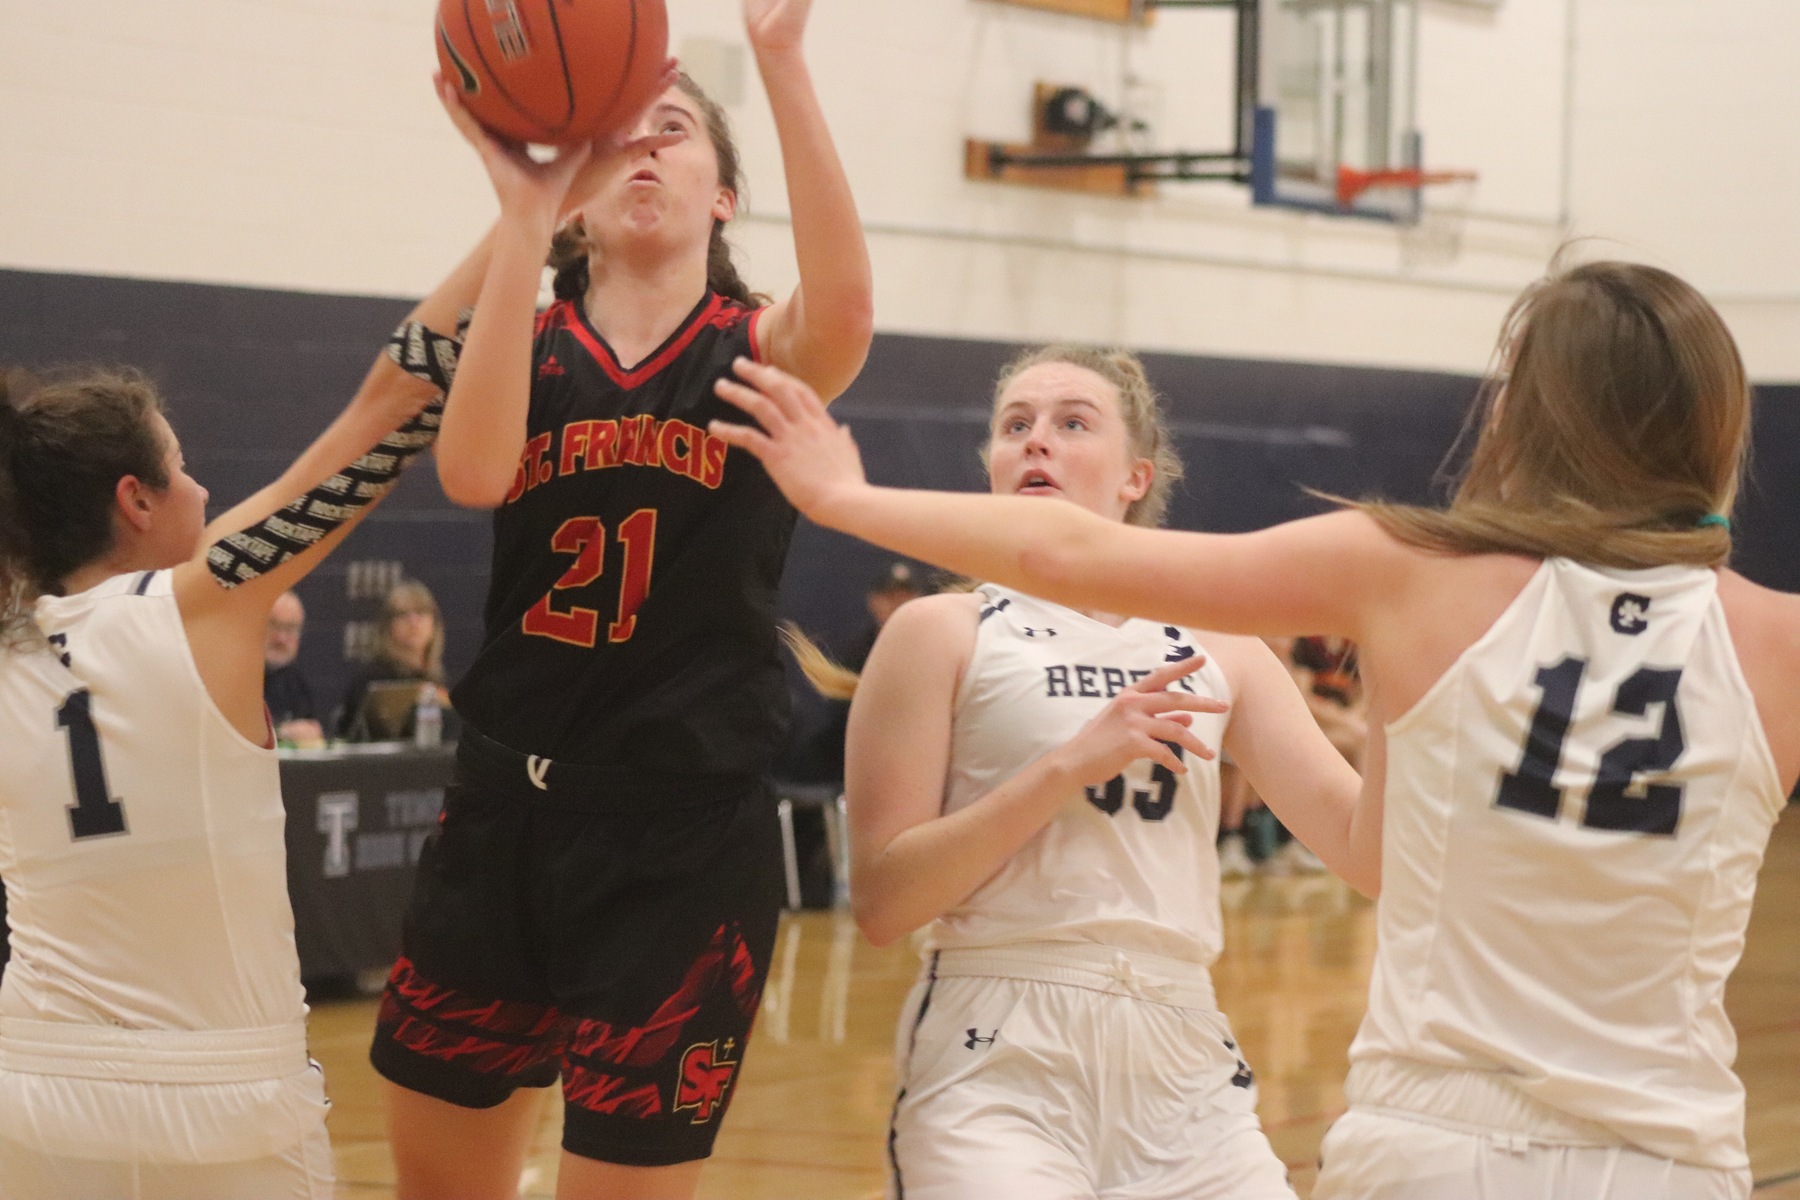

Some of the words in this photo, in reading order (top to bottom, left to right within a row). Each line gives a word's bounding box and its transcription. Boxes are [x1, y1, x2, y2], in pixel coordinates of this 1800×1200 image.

[522, 508, 659, 648] 21
[1045, 663, 1198, 699] REB
[1490, 653, 1691, 840] 12
[53, 687, 132, 843] 1
